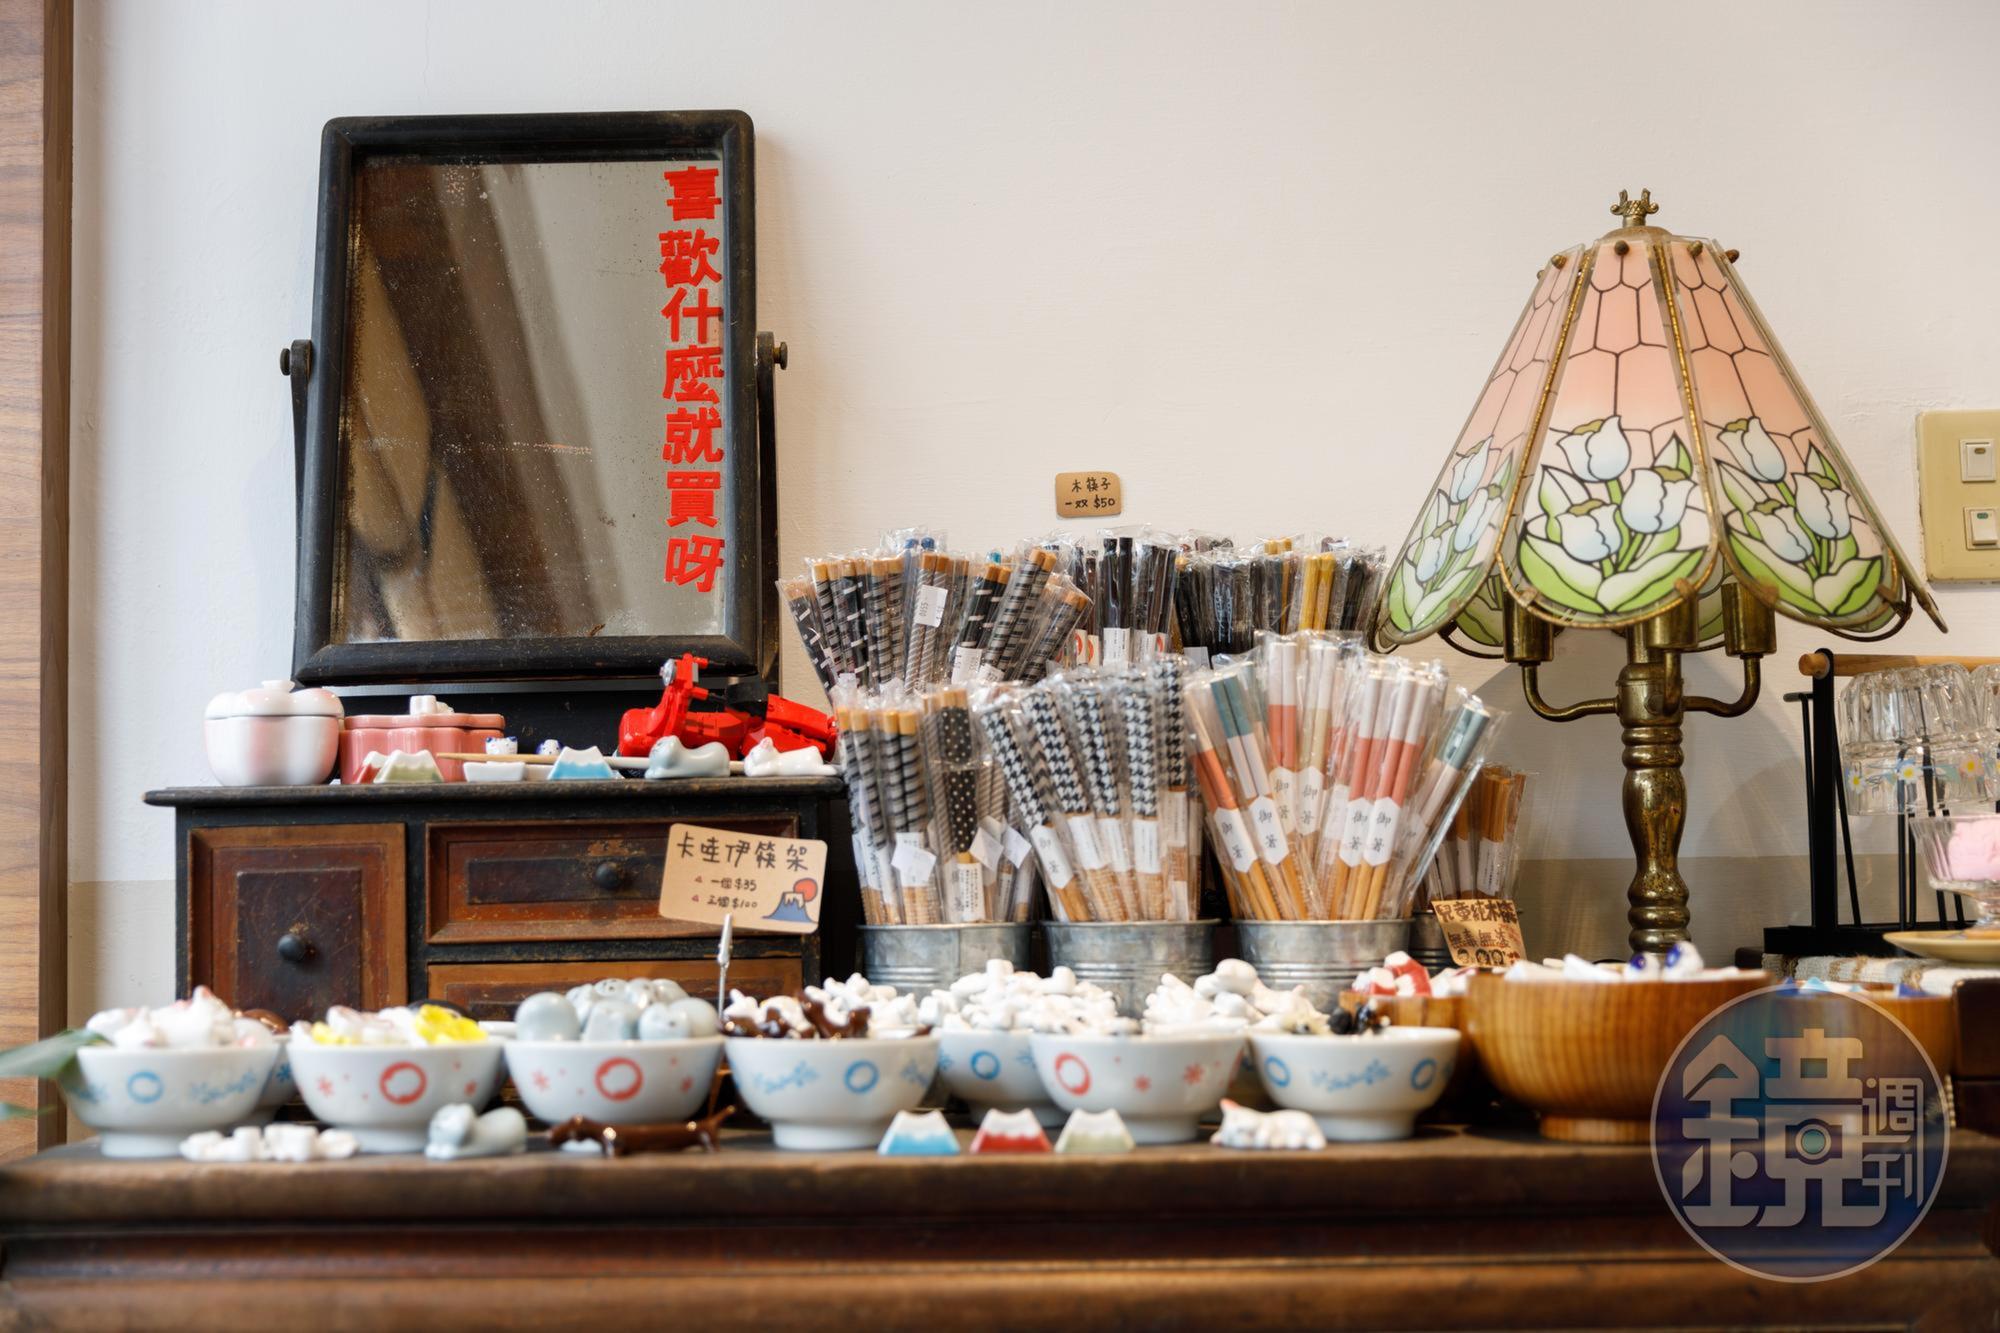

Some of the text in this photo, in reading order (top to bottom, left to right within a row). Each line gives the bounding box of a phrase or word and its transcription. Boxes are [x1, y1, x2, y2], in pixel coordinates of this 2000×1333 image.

[659, 165, 725, 593] 喜歡什麼就買呀
[1072, 477, 1111, 493] 木筷子
[1094, 494, 1116, 509] $50
[676, 831, 808, 871] 卡哇伊筷架
